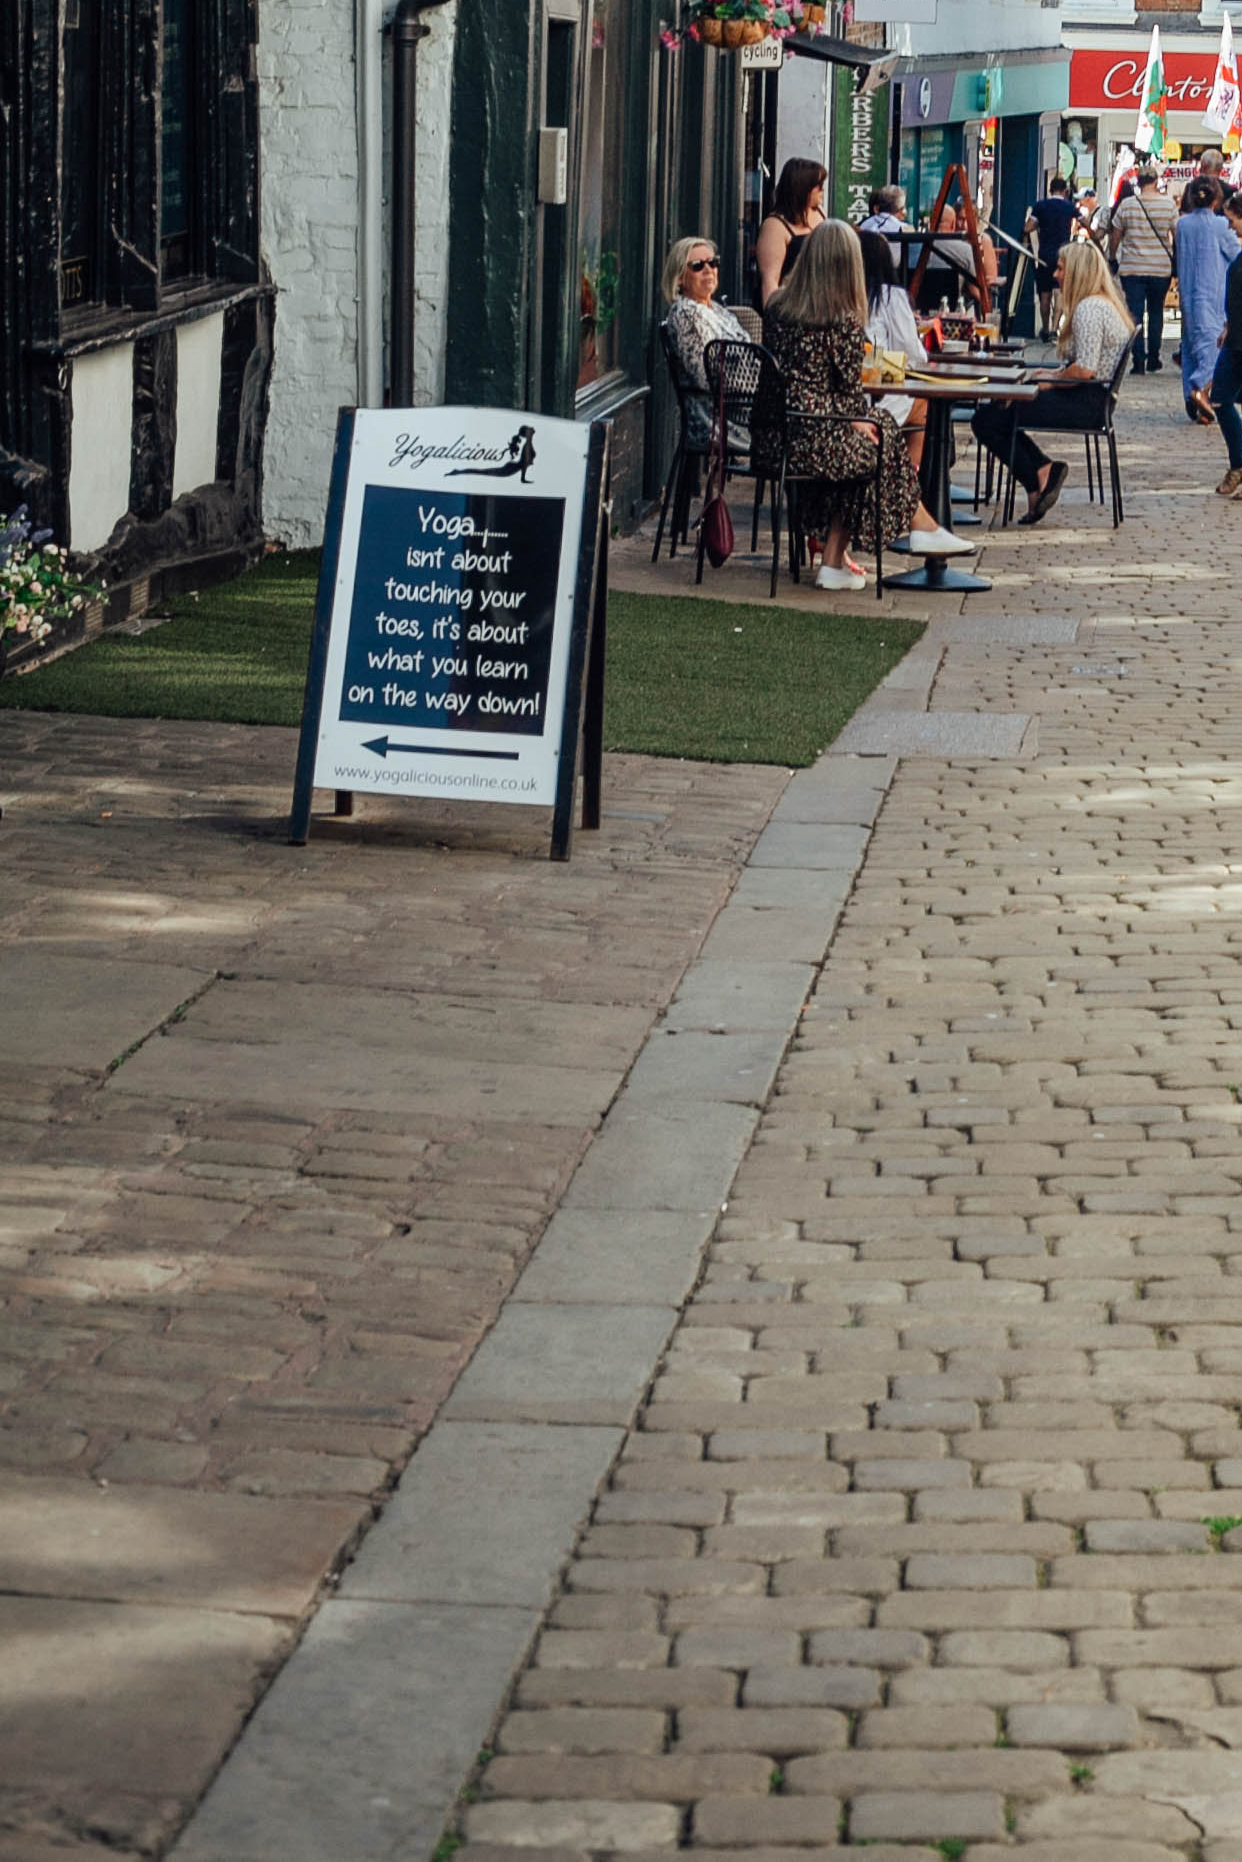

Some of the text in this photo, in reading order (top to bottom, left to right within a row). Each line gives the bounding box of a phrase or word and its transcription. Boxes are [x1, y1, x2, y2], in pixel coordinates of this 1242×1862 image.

[744, 43, 778, 60] cycling
[388, 432, 510, 470] Yogalicious
[406, 546, 512, 574] isnt about
[384, 578, 527, 610] touching your
[375, 611, 529, 645] toes, it's about
[367, 649, 528, 680] what you learn
[347, 682, 541, 717] on the way down!
[334, 765, 538, 792] www.yogaliciousonline.co.uk
